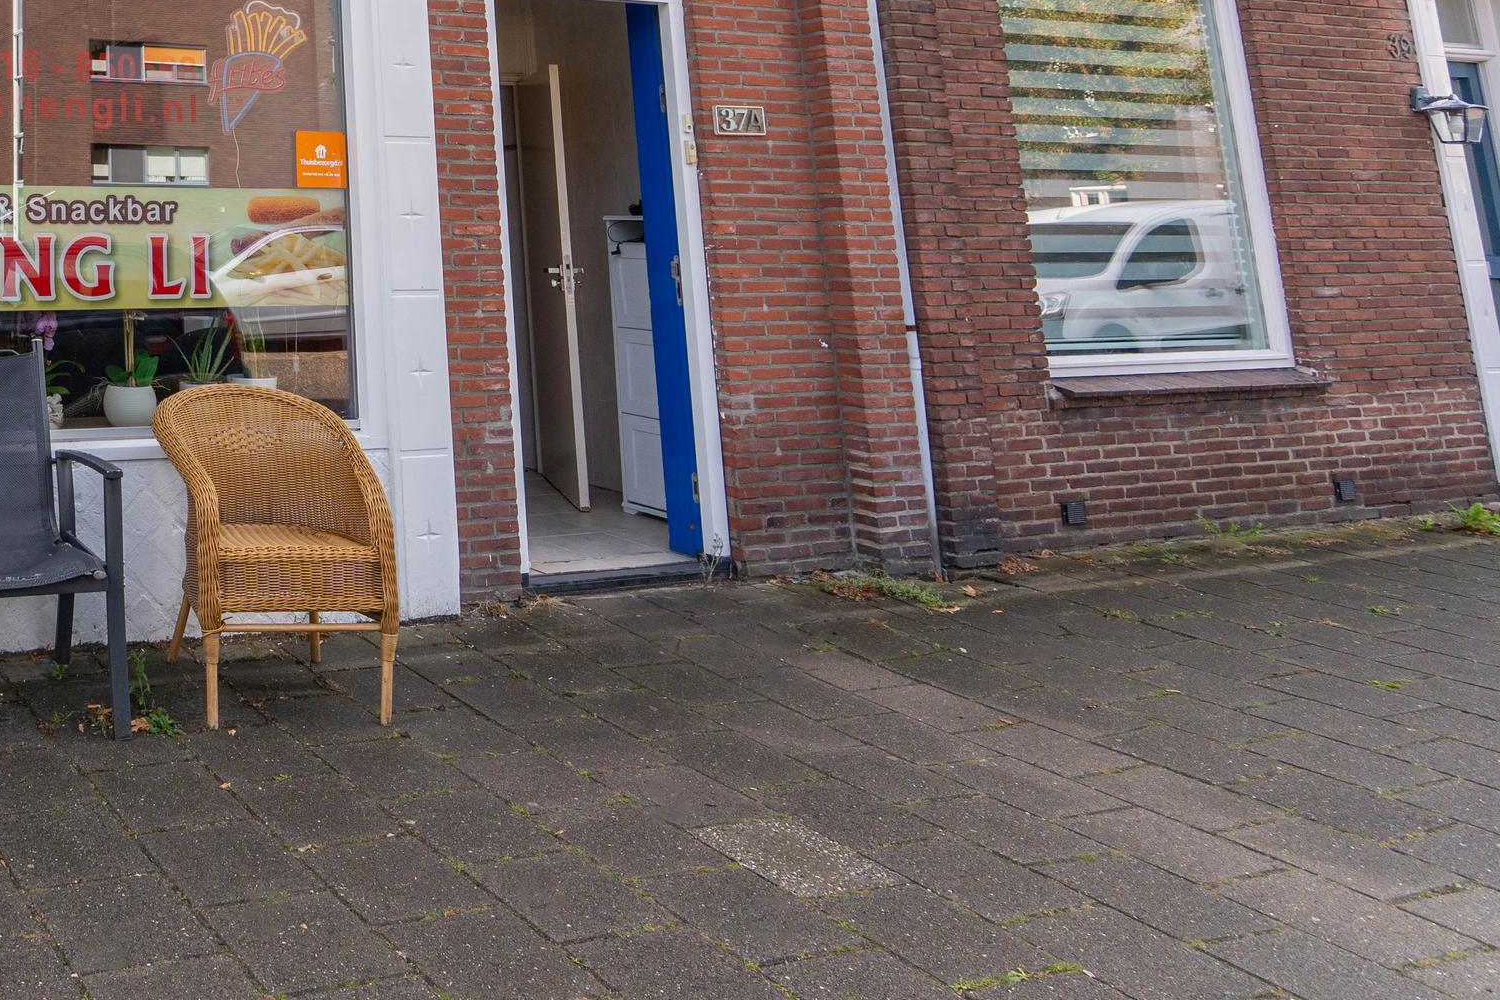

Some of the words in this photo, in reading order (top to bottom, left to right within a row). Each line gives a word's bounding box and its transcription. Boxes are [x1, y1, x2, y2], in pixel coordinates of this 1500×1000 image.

[208, 59, 285, 104] frites
[720, 108, 763, 132] 37A
[27, 195, 176, 222] Snackbar
[147, 231, 212, 300] LI
